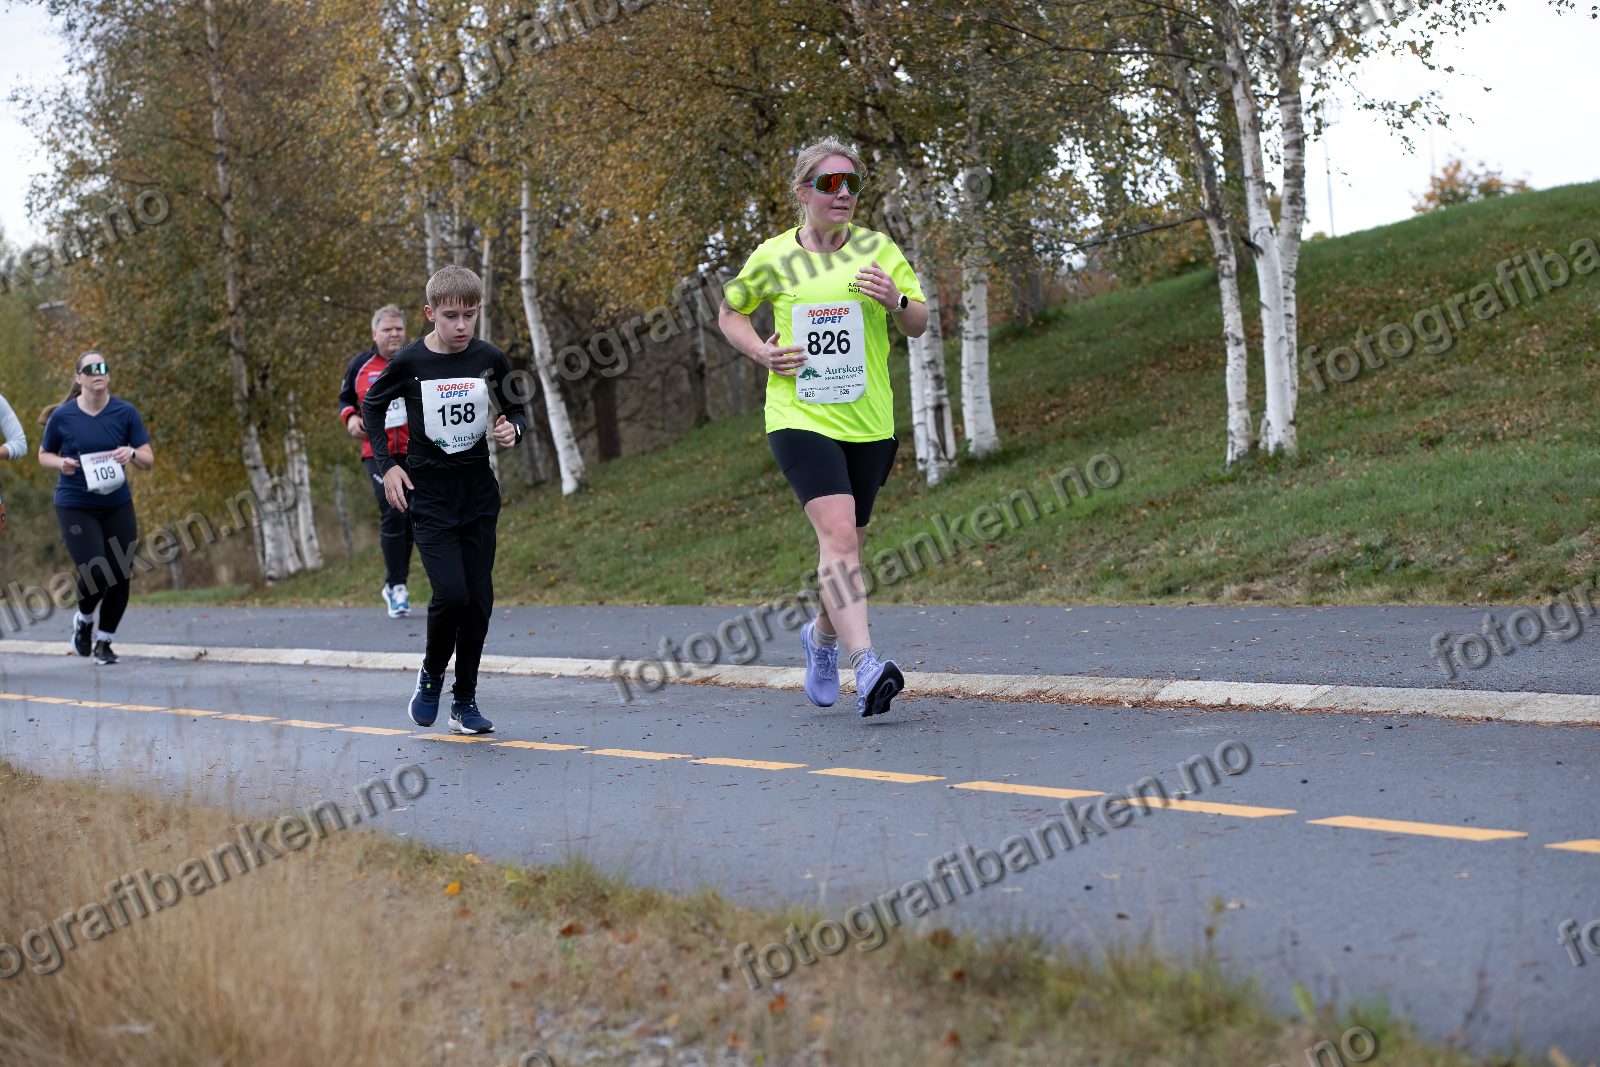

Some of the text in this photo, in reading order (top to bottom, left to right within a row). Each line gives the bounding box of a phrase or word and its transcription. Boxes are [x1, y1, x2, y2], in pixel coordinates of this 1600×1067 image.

[807, 307, 849, 318] NORGES
[812, 315, 843, 325] LØPET
[807, 329, 851, 356] 826
[824, 364, 864, 376] Aurskog
[436, 382, 475, 392] NORGES
[440, 389, 470, 399] LØPET
[437, 402, 476, 427] 158
[93, 465, 116, 482] 109
